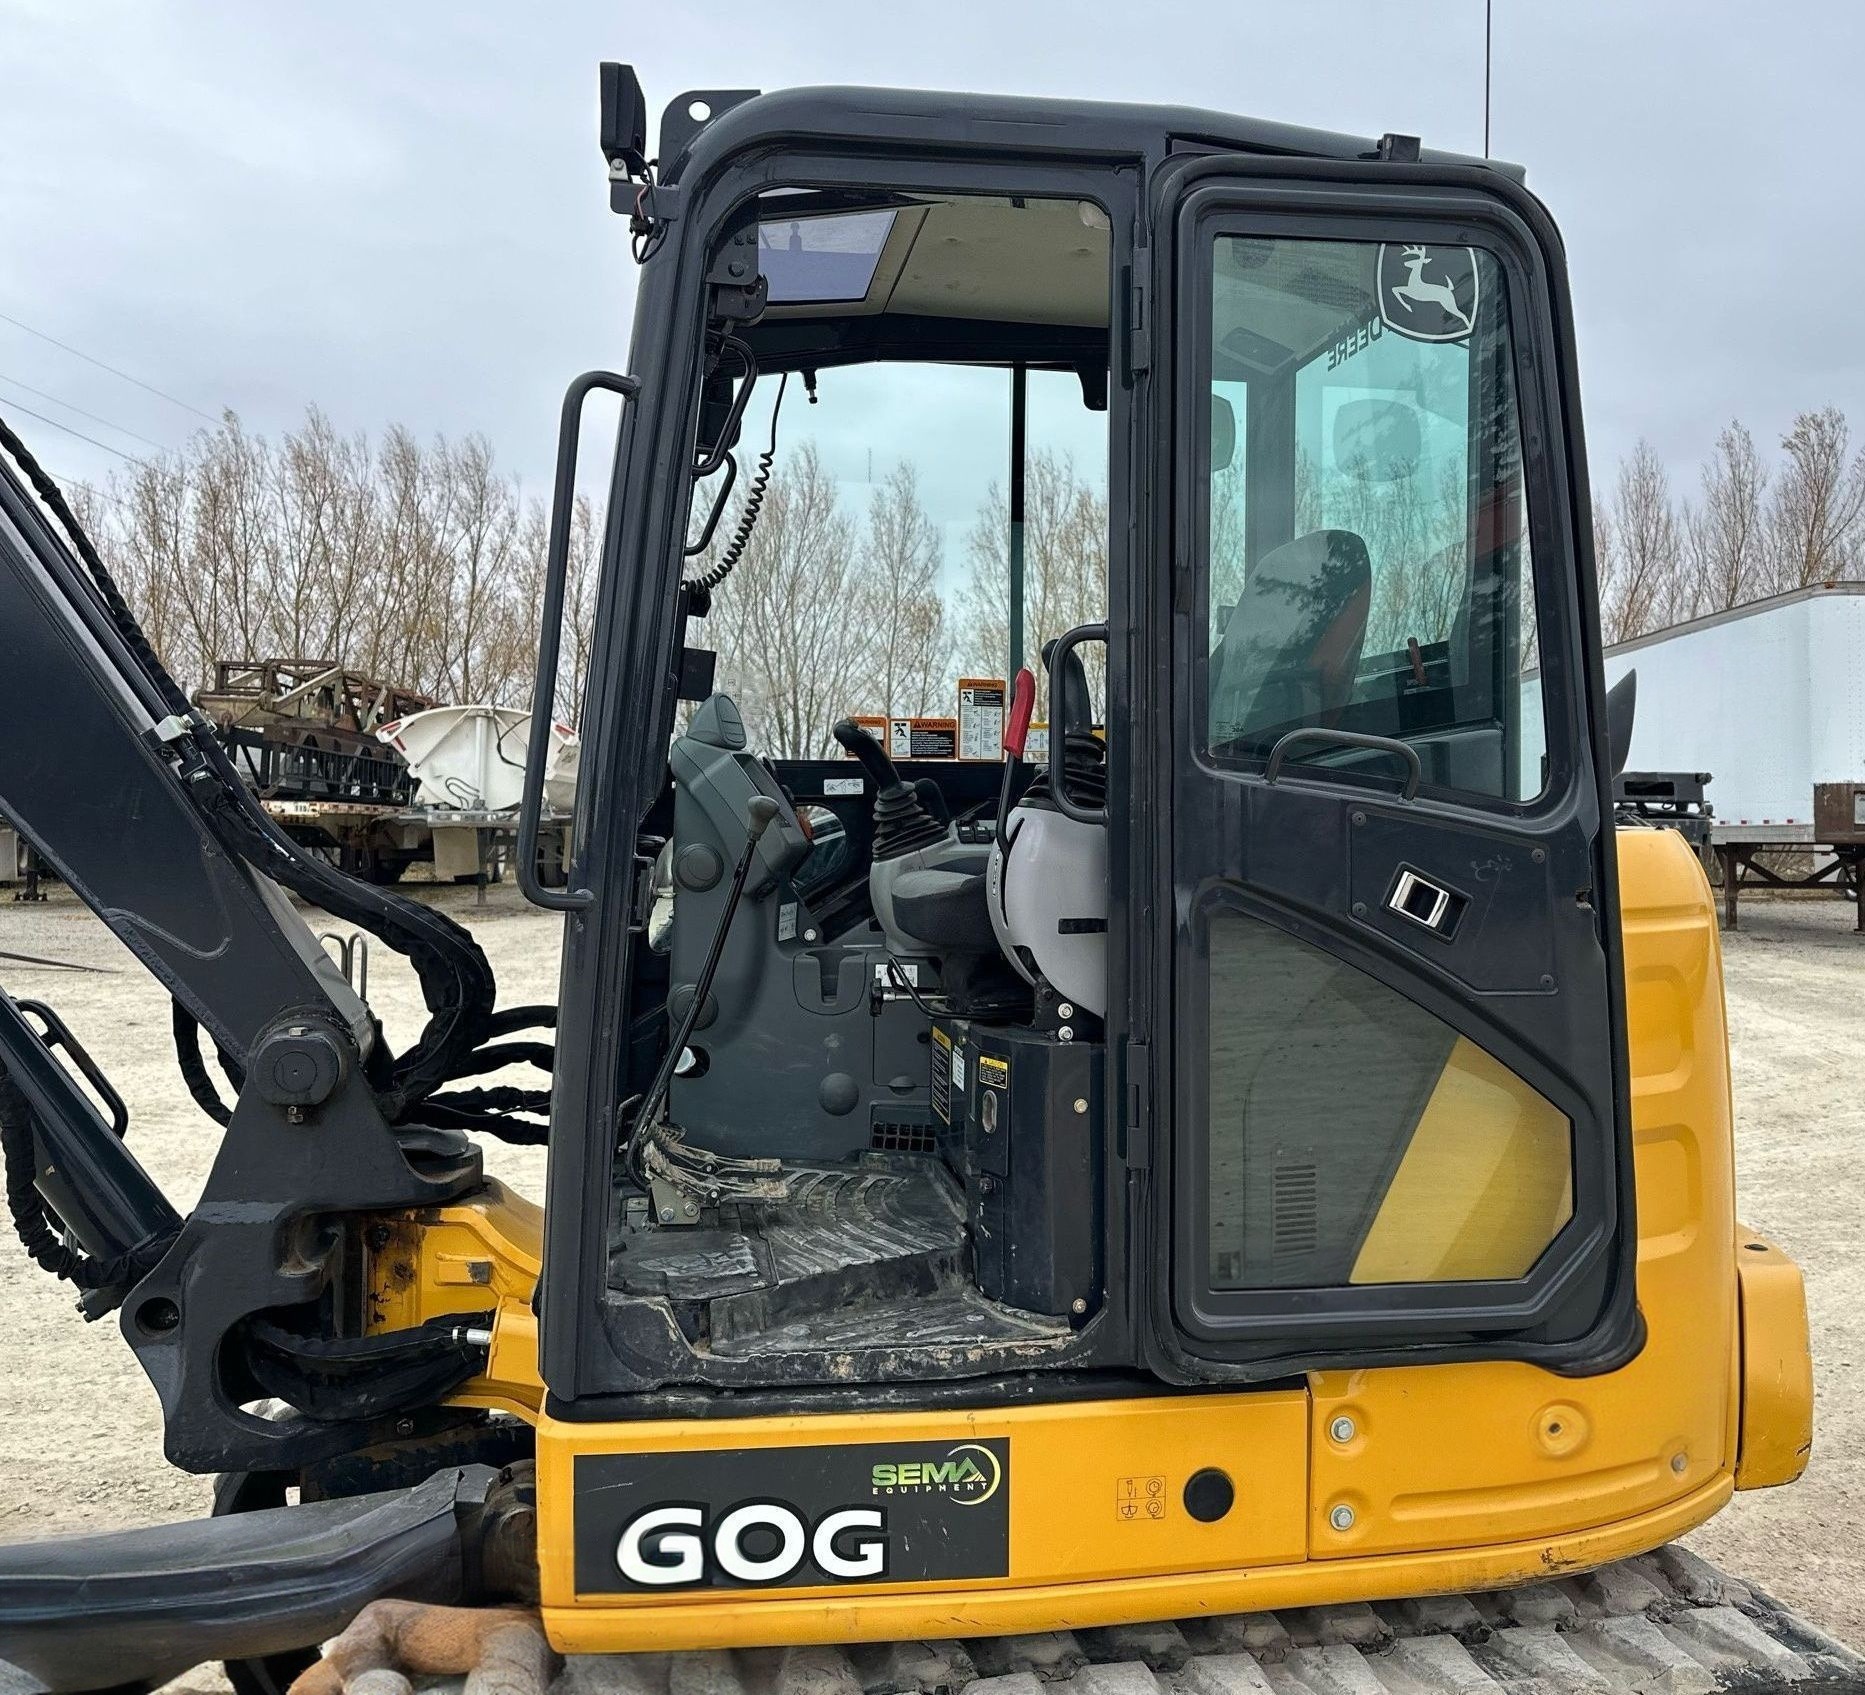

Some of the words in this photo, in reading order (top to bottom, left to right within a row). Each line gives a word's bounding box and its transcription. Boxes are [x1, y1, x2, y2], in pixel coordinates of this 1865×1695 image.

[920, 721, 956, 729] WARNING
[872, 1457, 987, 1486] SEMA
[872, 1482, 988, 1495] EQUIPMENT
